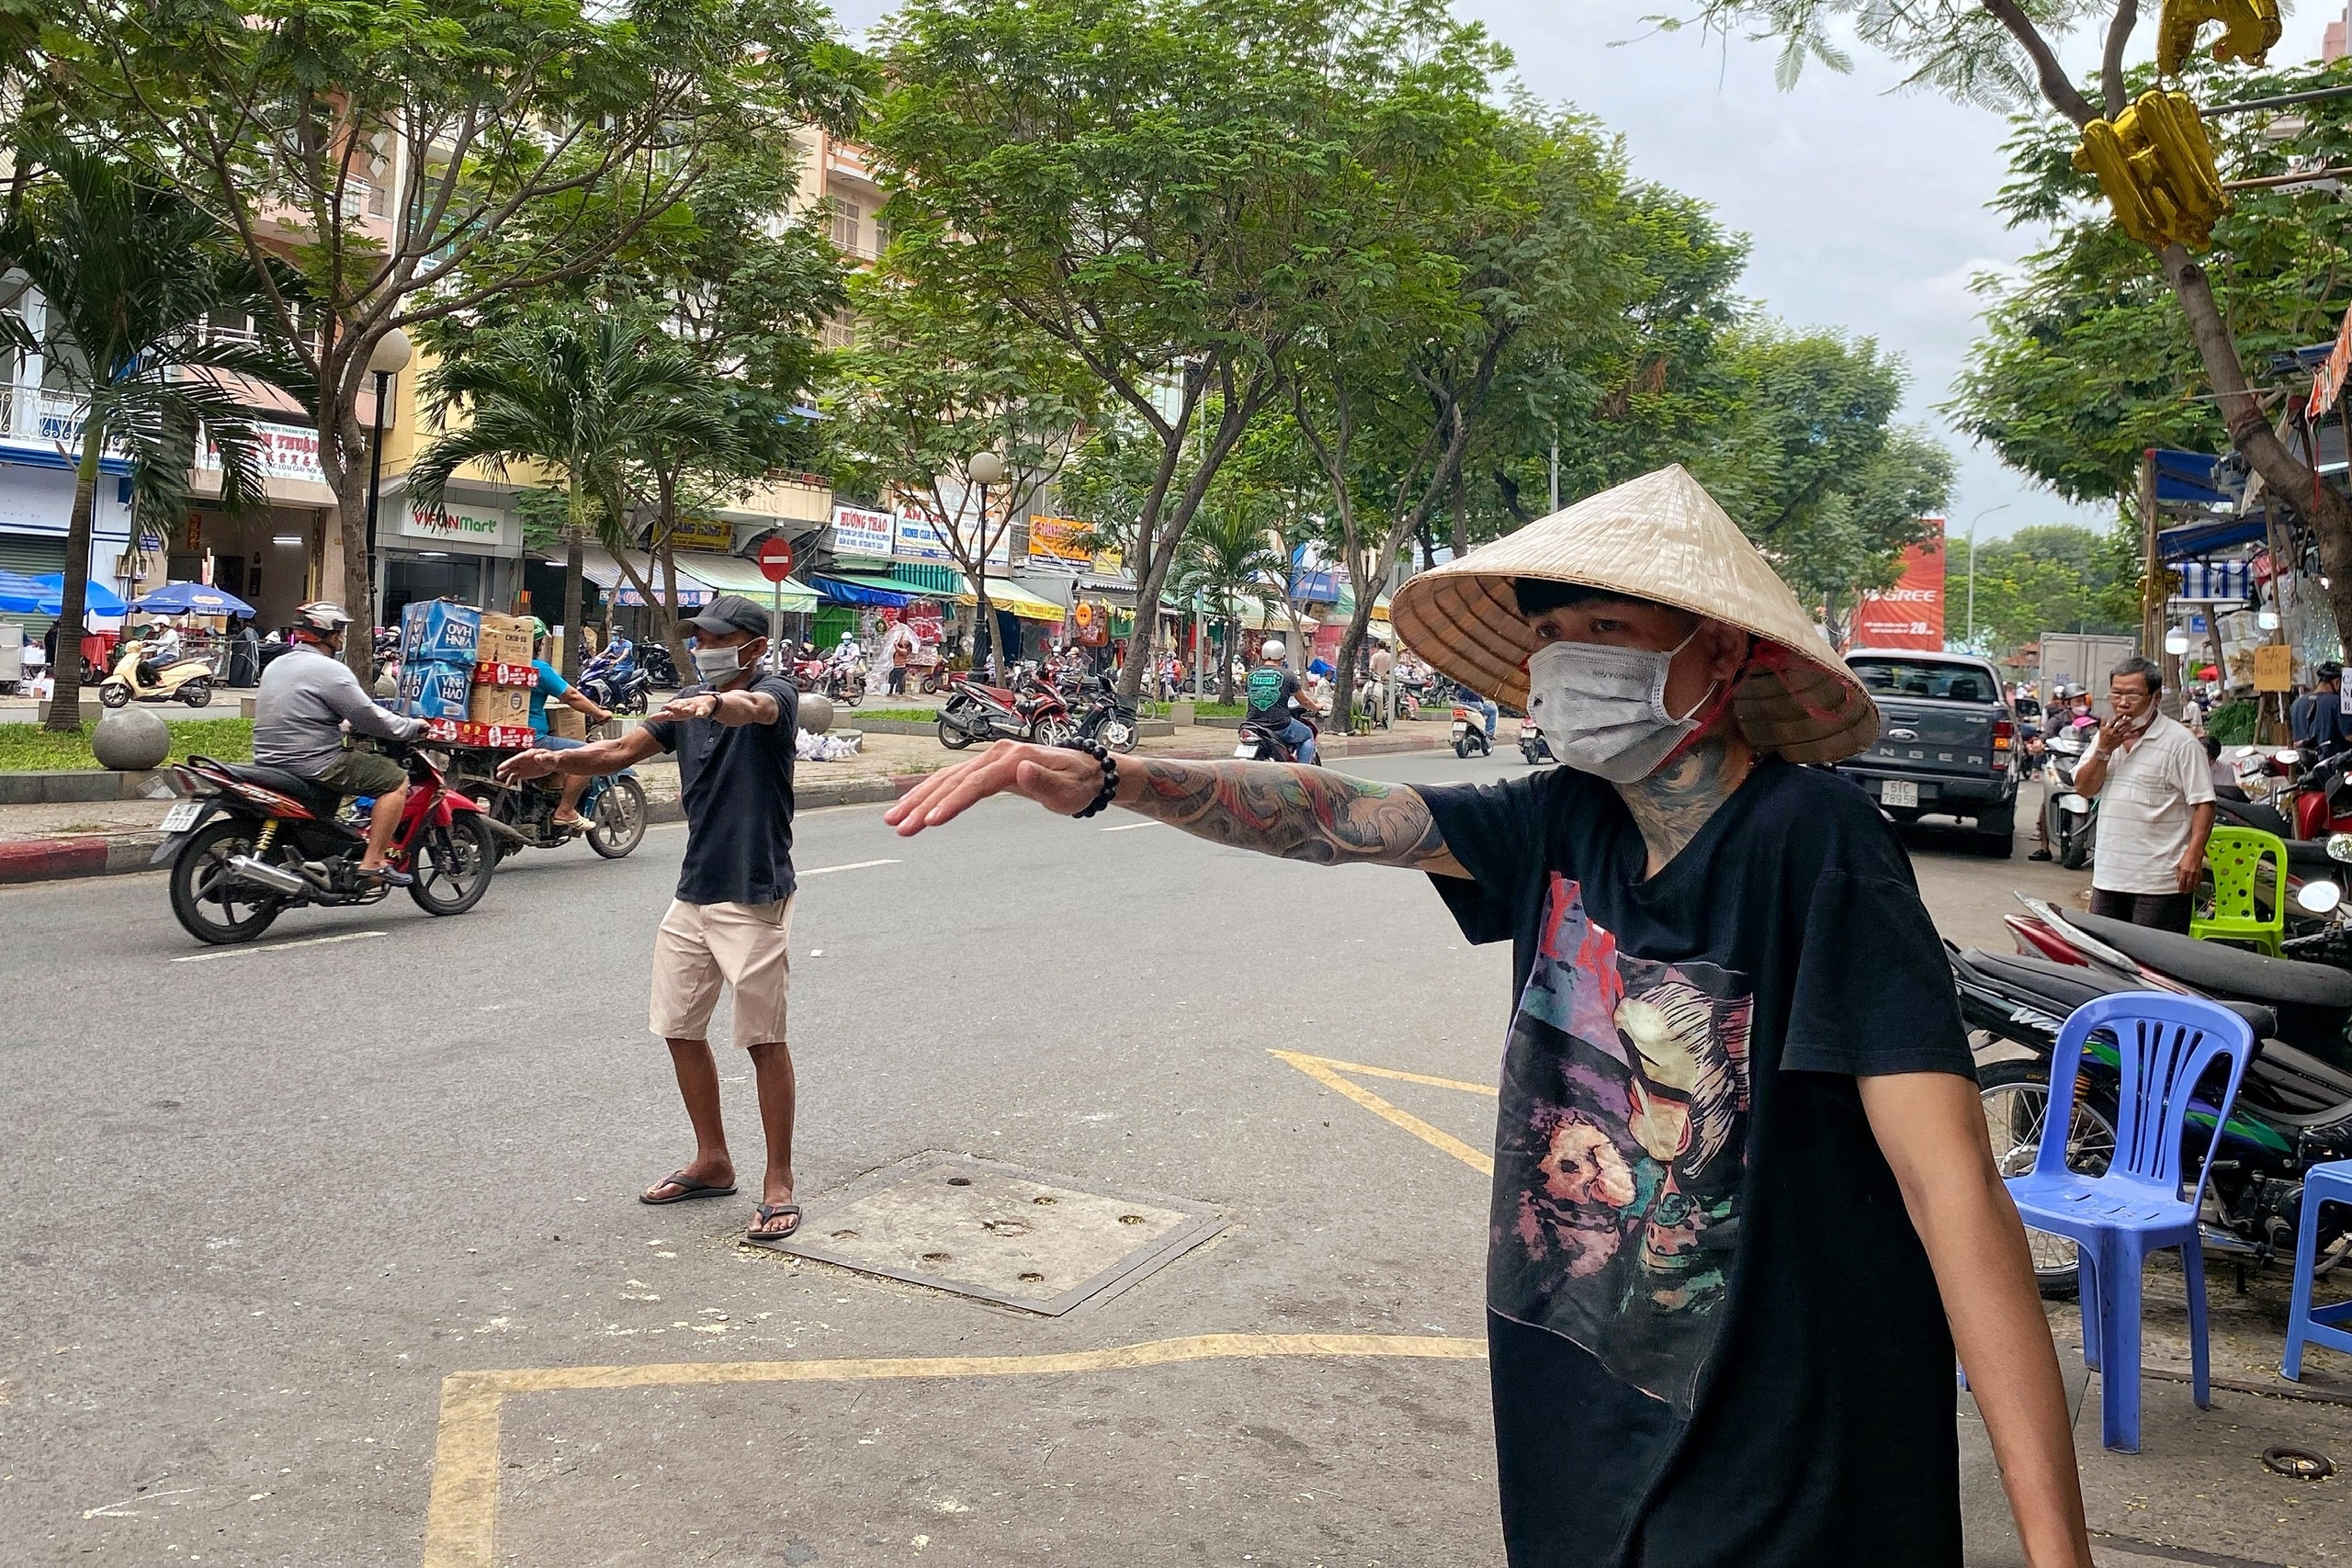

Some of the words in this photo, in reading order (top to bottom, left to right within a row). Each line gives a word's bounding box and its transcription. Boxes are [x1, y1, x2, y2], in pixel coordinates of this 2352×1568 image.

[1882, 589, 1938, 603] GREE
[1909, 621, 1928, 635] 20
[401, 686, 420, 697] HO
[1879, 747, 1984, 764] NGER
[1891, 782, 1910, 794] 51C
[1882, 793, 1917, 805] 78958
